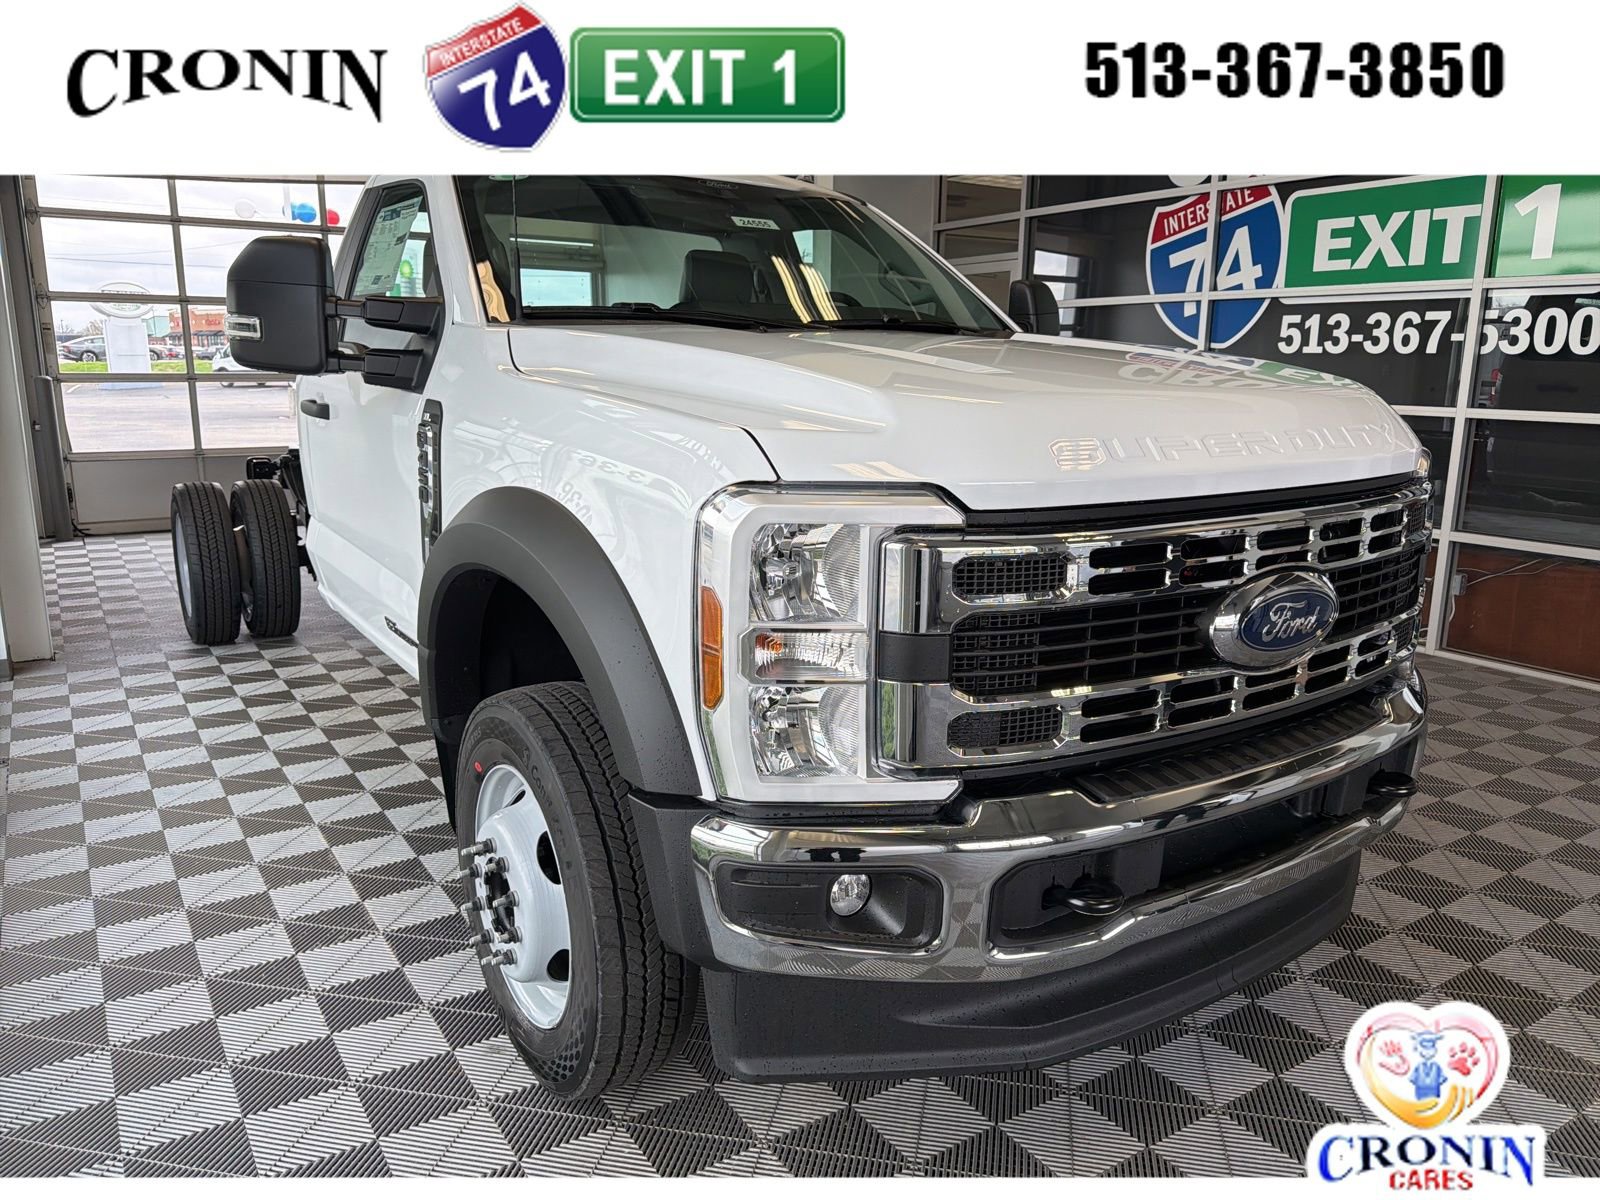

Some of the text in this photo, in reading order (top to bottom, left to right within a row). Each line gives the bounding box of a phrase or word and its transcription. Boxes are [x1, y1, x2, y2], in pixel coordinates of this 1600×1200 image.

[1163, 187, 1255, 236] INTERSATE
[1313, 183, 1562, 272] EXIT 1
[1169, 225, 1262, 318] 74
[1262, 600, 1320, 642] Ford
